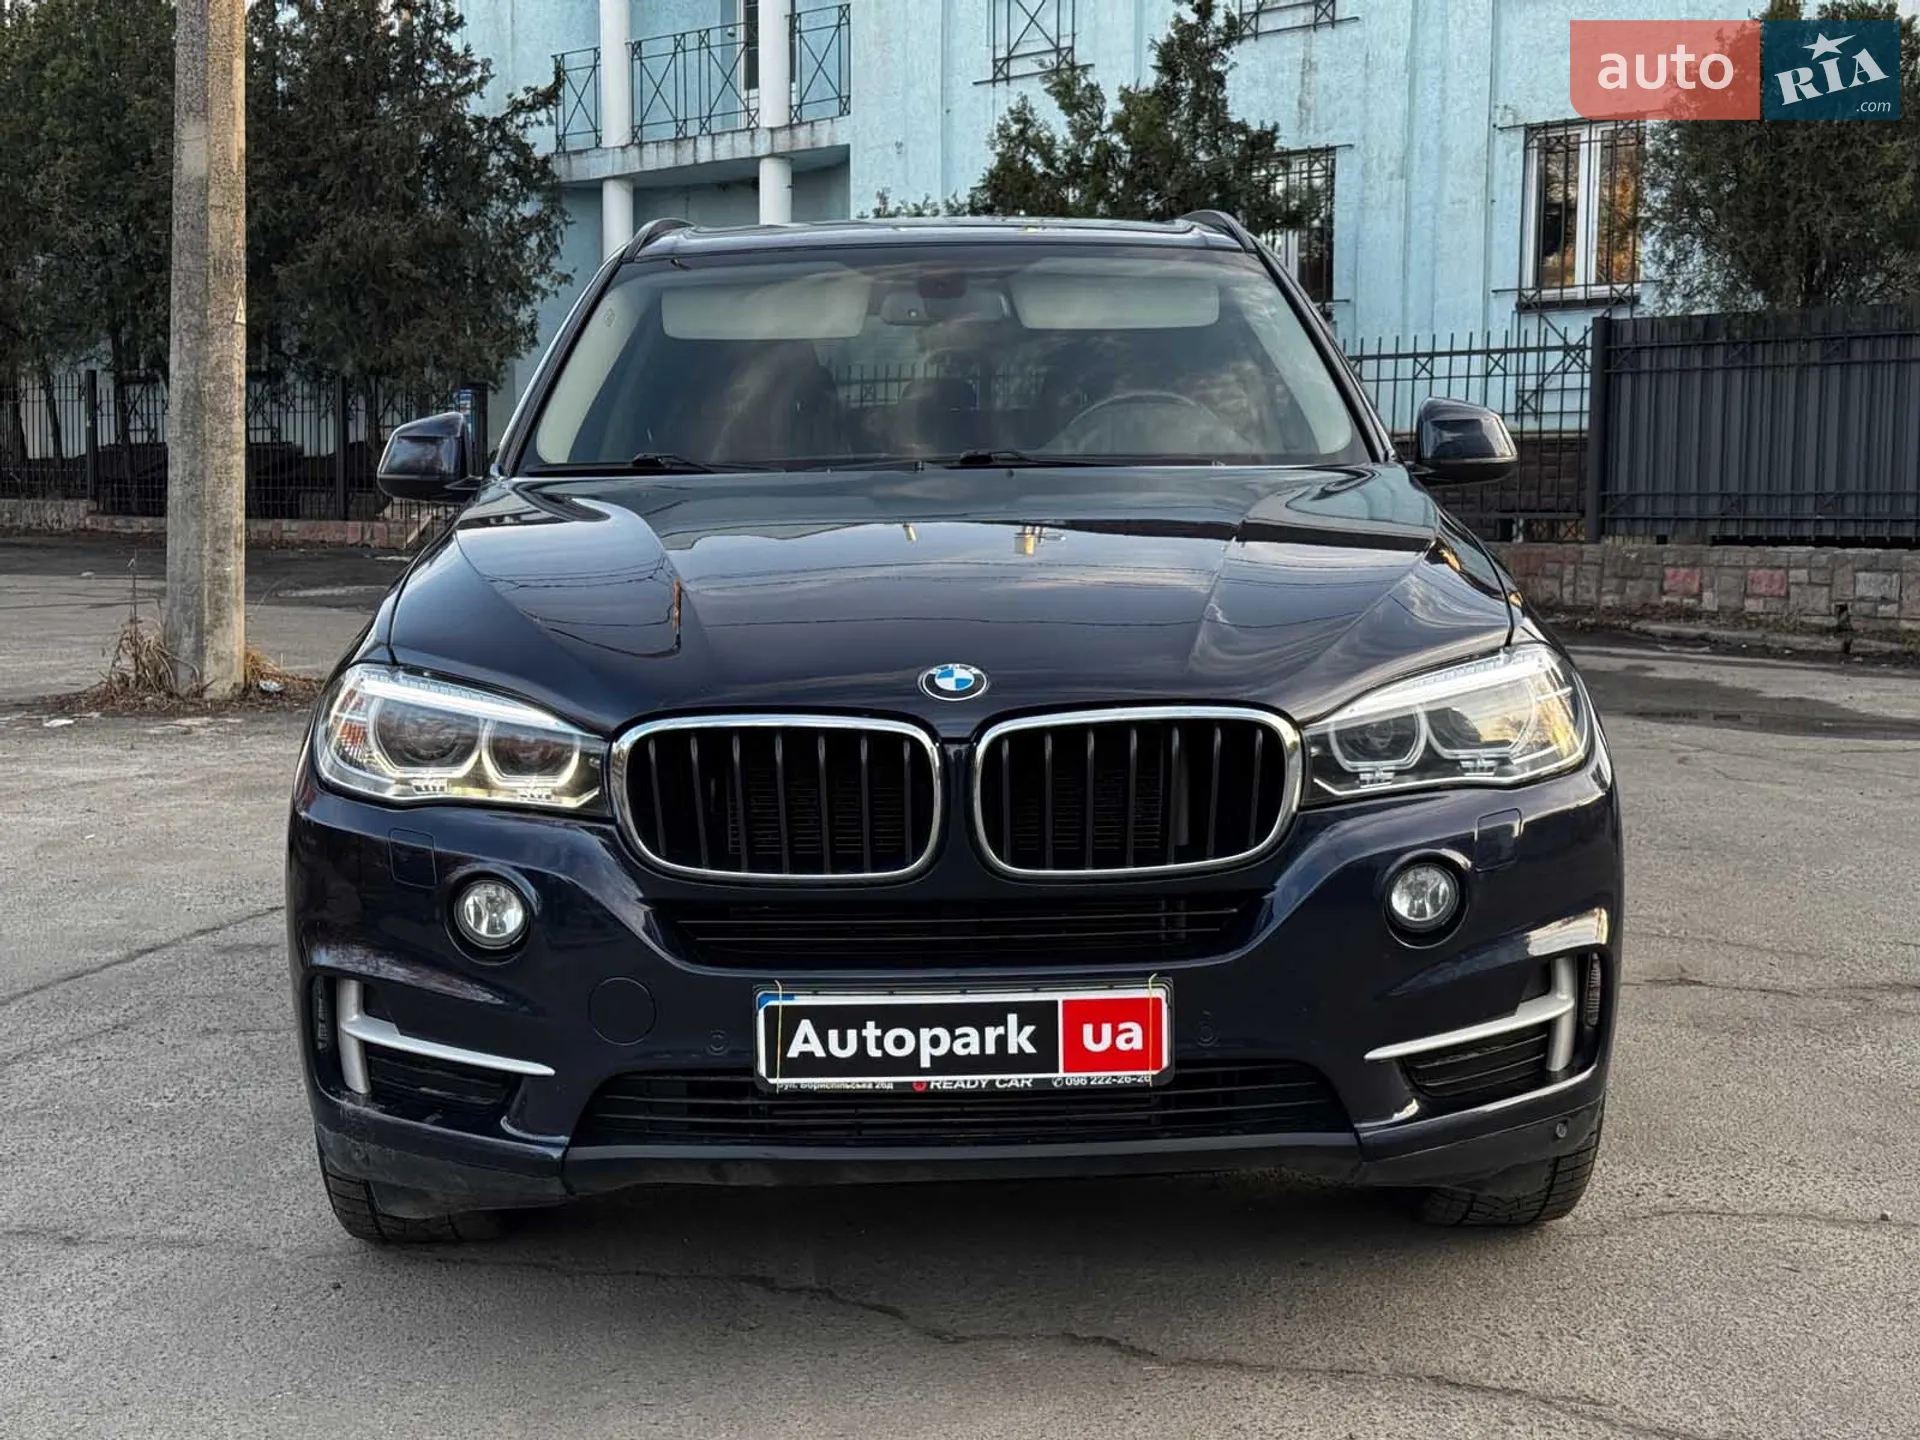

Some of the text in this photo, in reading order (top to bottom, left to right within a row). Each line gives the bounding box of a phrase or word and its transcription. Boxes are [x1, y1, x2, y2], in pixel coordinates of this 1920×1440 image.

[786, 1013, 1143, 1069] Autopark ua
[929, 1077, 1033, 1089] READY CAR
